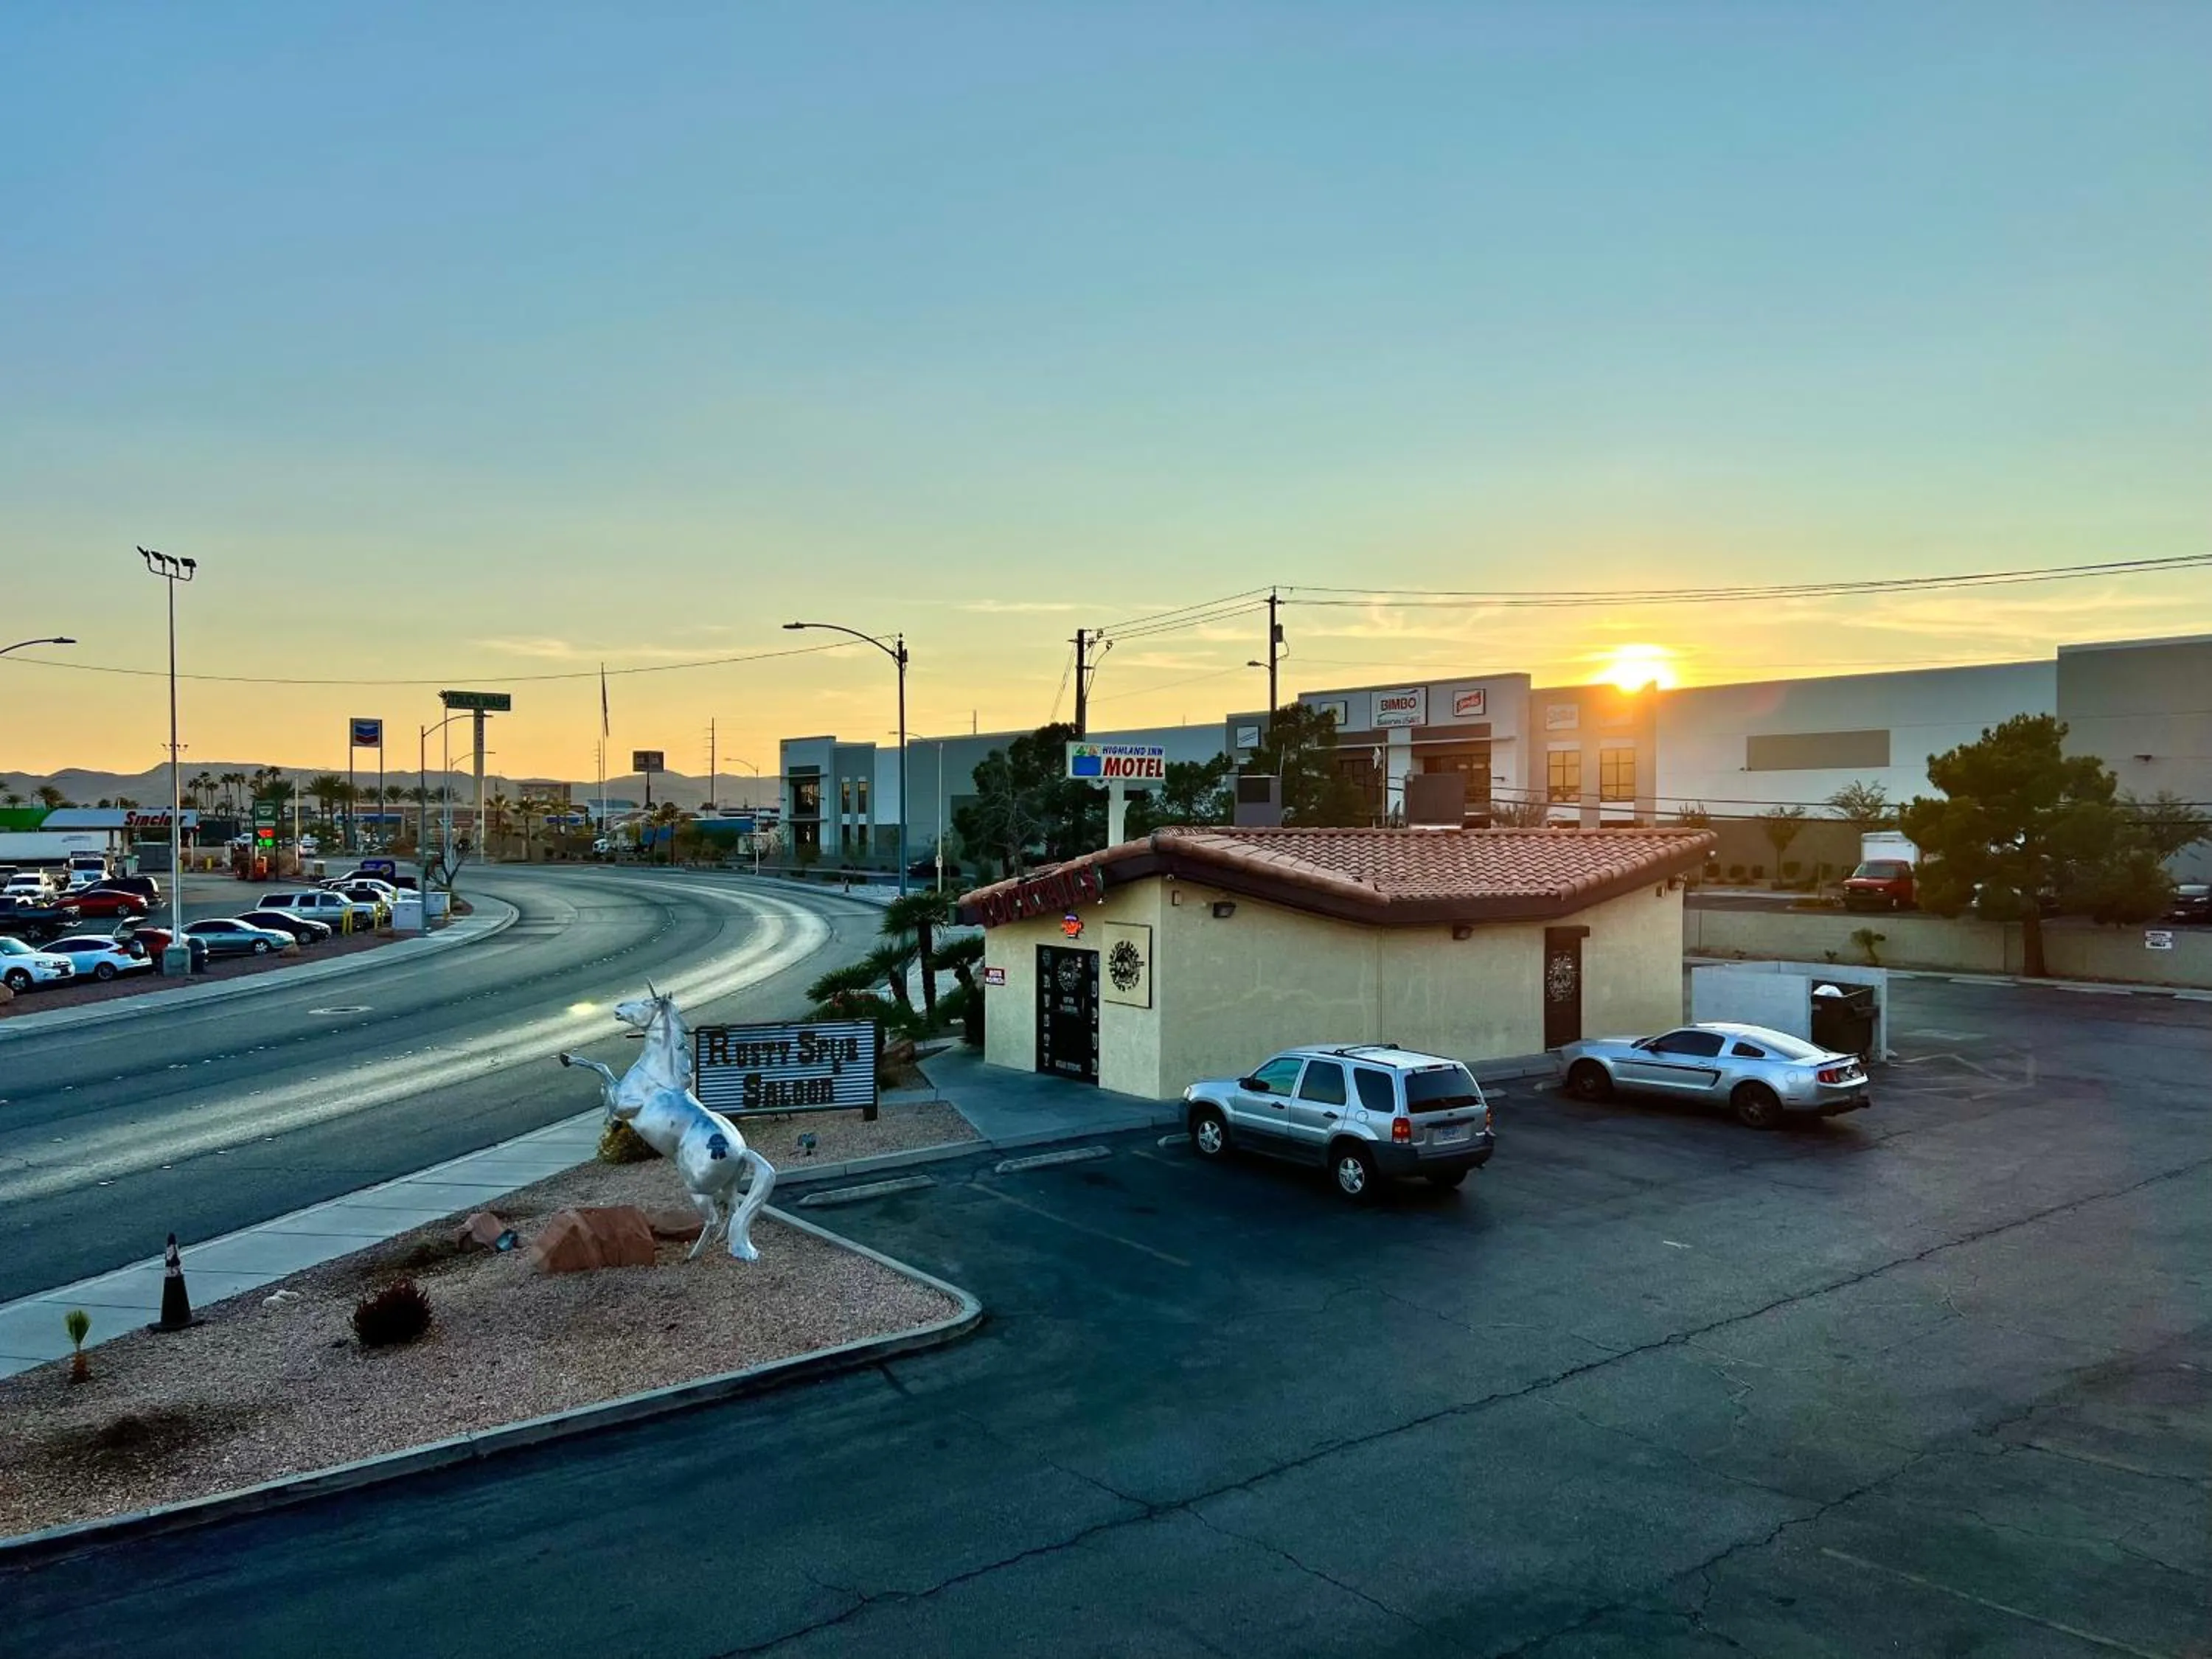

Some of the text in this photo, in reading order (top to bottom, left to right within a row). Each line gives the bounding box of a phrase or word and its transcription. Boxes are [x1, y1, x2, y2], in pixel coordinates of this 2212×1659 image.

[1381, 697, 1416, 712] BIMBO
[1103, 745, 1164, 756] HIGHLAND INN
[1103, 757, 1164, 778] MOTEL
[124, 810, 187, 827] Sinclar
